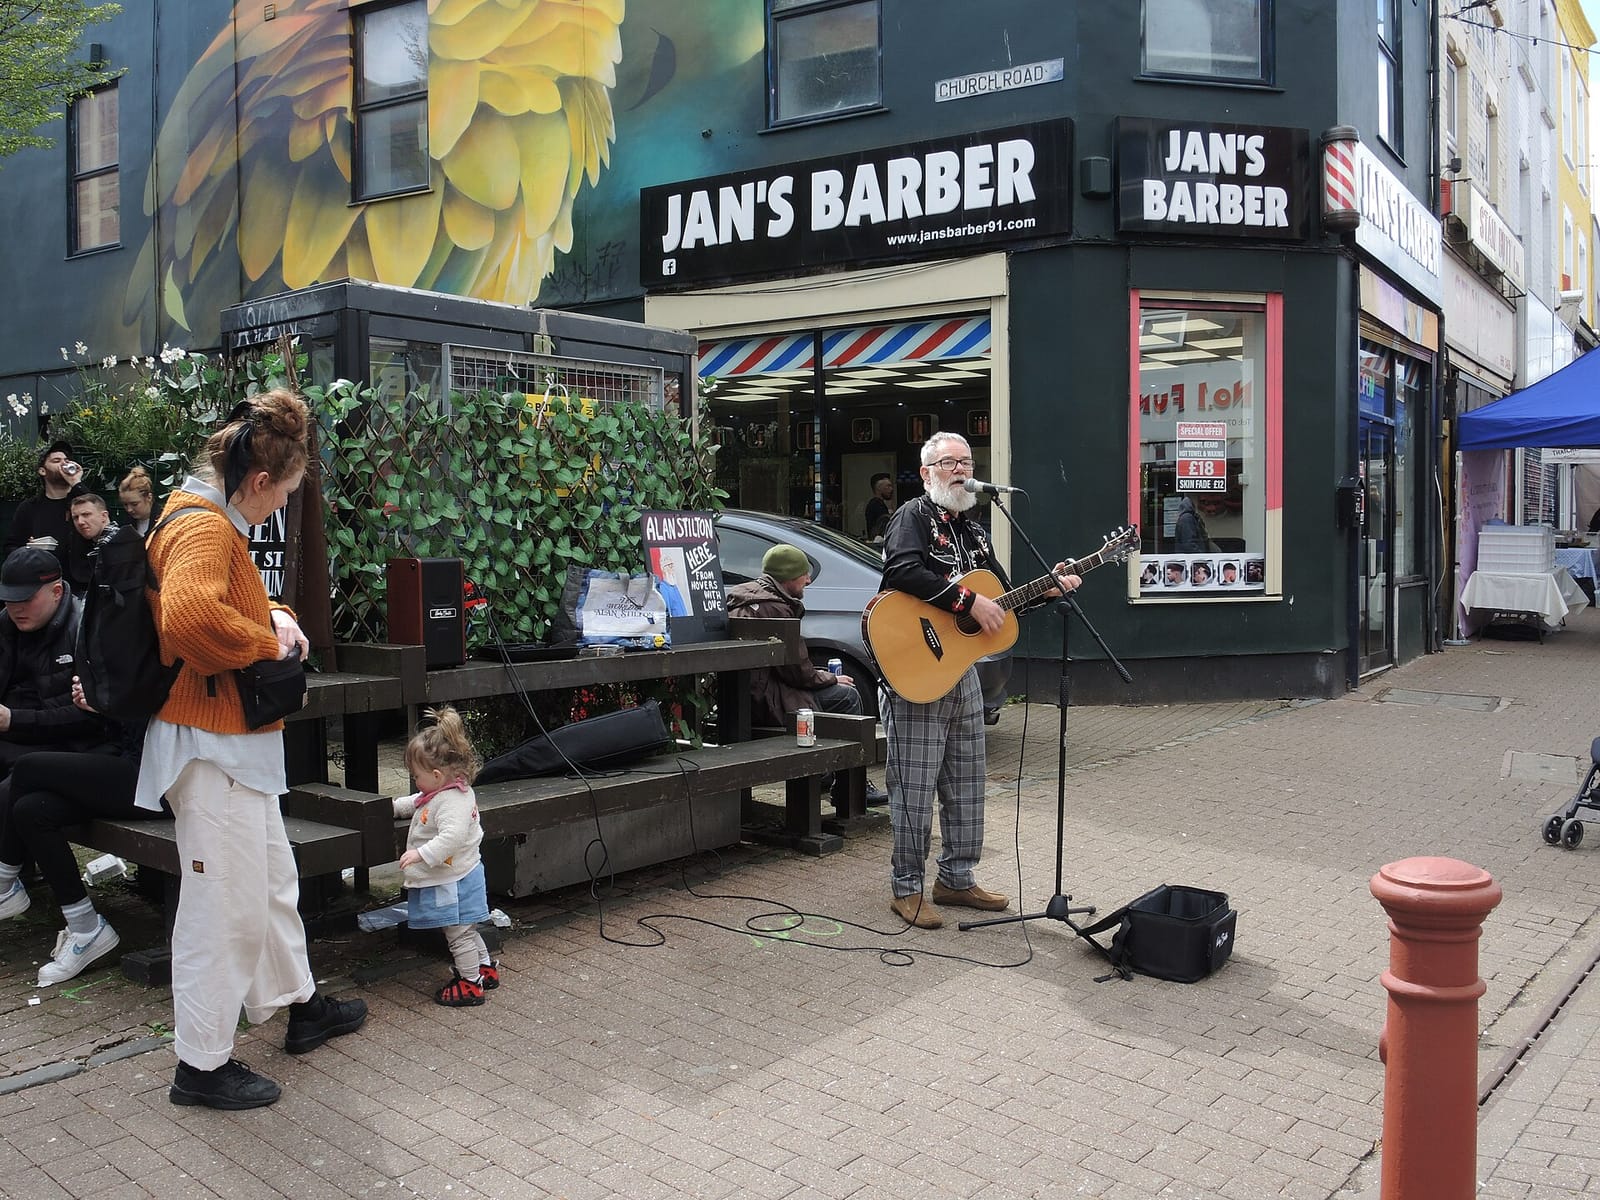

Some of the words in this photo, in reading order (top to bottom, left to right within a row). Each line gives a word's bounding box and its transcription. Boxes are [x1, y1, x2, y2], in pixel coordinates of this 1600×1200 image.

[940, 73, 1001, 97] CHURCH
[1003, 65, 1043, 88] ROAD
[1165, 130, 1266, 177] JAN'S
[662, 175, 795, 253] JAN'S
[811, 138, 1036, 231] BARBER
[1143, 179, 1289, 227] BARBER
[1360, 156, 1397, 242] JAN'S
[1398, 191, 1441, 278] BARBER
[887, 217, 1036, 245] www.jansbarber91.com
[1180, 427, 1203, 435] SPECIAL
[1205, 428, 1222, 436] OFFER
[1189, 461, 1214, 476] £18
[1180, 480, 1194, 489] SKIN
[1196, 480, 1211, 489] FADE
[646, 516, 677, 541] ALAN
[676, 517, 713, 539] STILTON
[685, 541, 713, 570] HERE
[695, 571, 715, 580] FROM
[703, 591, 722, 600] WITH
[594, 608, 618, 619] ALAN
